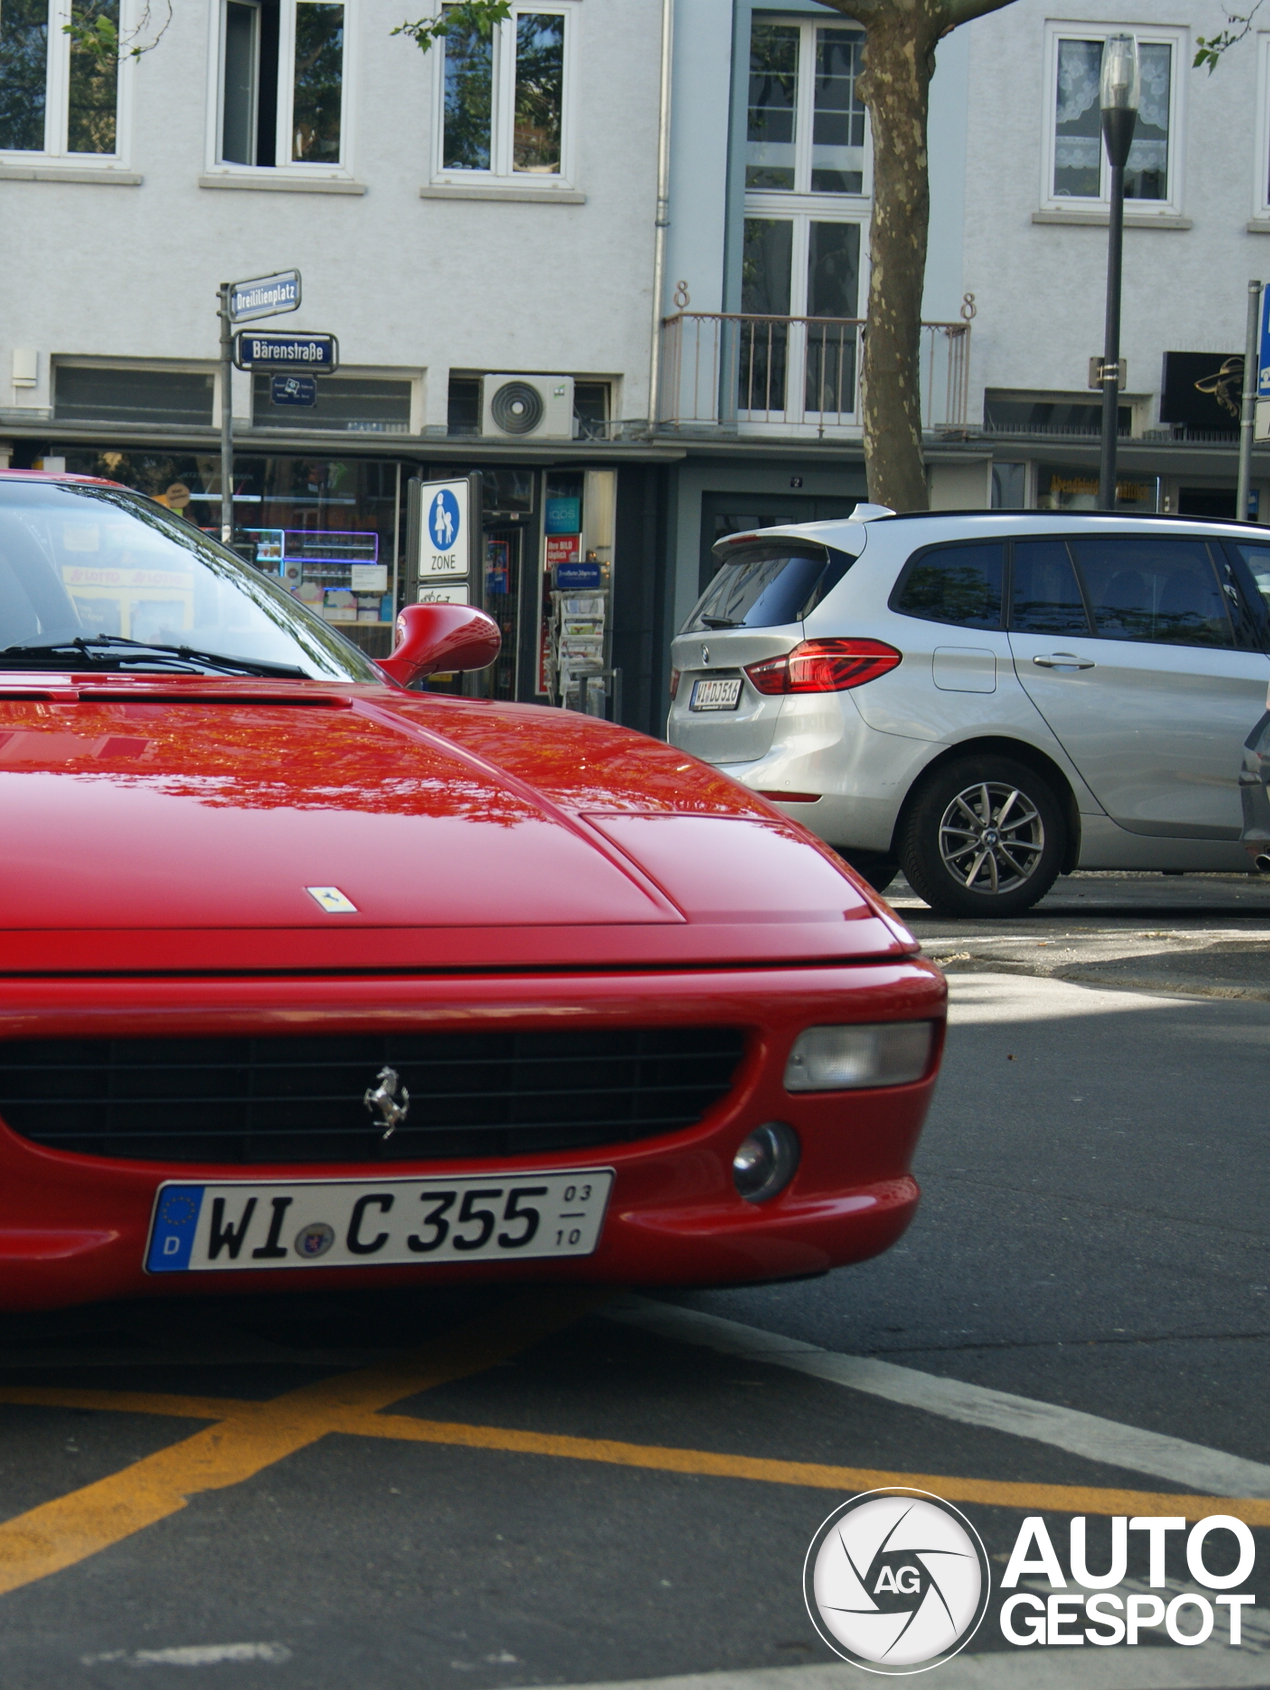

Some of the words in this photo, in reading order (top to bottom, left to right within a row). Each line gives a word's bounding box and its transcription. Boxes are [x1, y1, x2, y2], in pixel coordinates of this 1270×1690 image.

[237, 284, 295, 309] Dreililienplatz
[252, 340, 324, 362] Bärenstraße
[560, 541, 573, 550] BILD
[431, 554, 456, 570] ZONE
[563, 1184, 593, 1202] 03
[207, 1196, 293, 1260] WI
[346, 1193, 395, 1255] C
[407, 1187, 549, 1251] 355
[163, 1236, 180, 1256] D
[555, 1229, 582, 1246] 10
